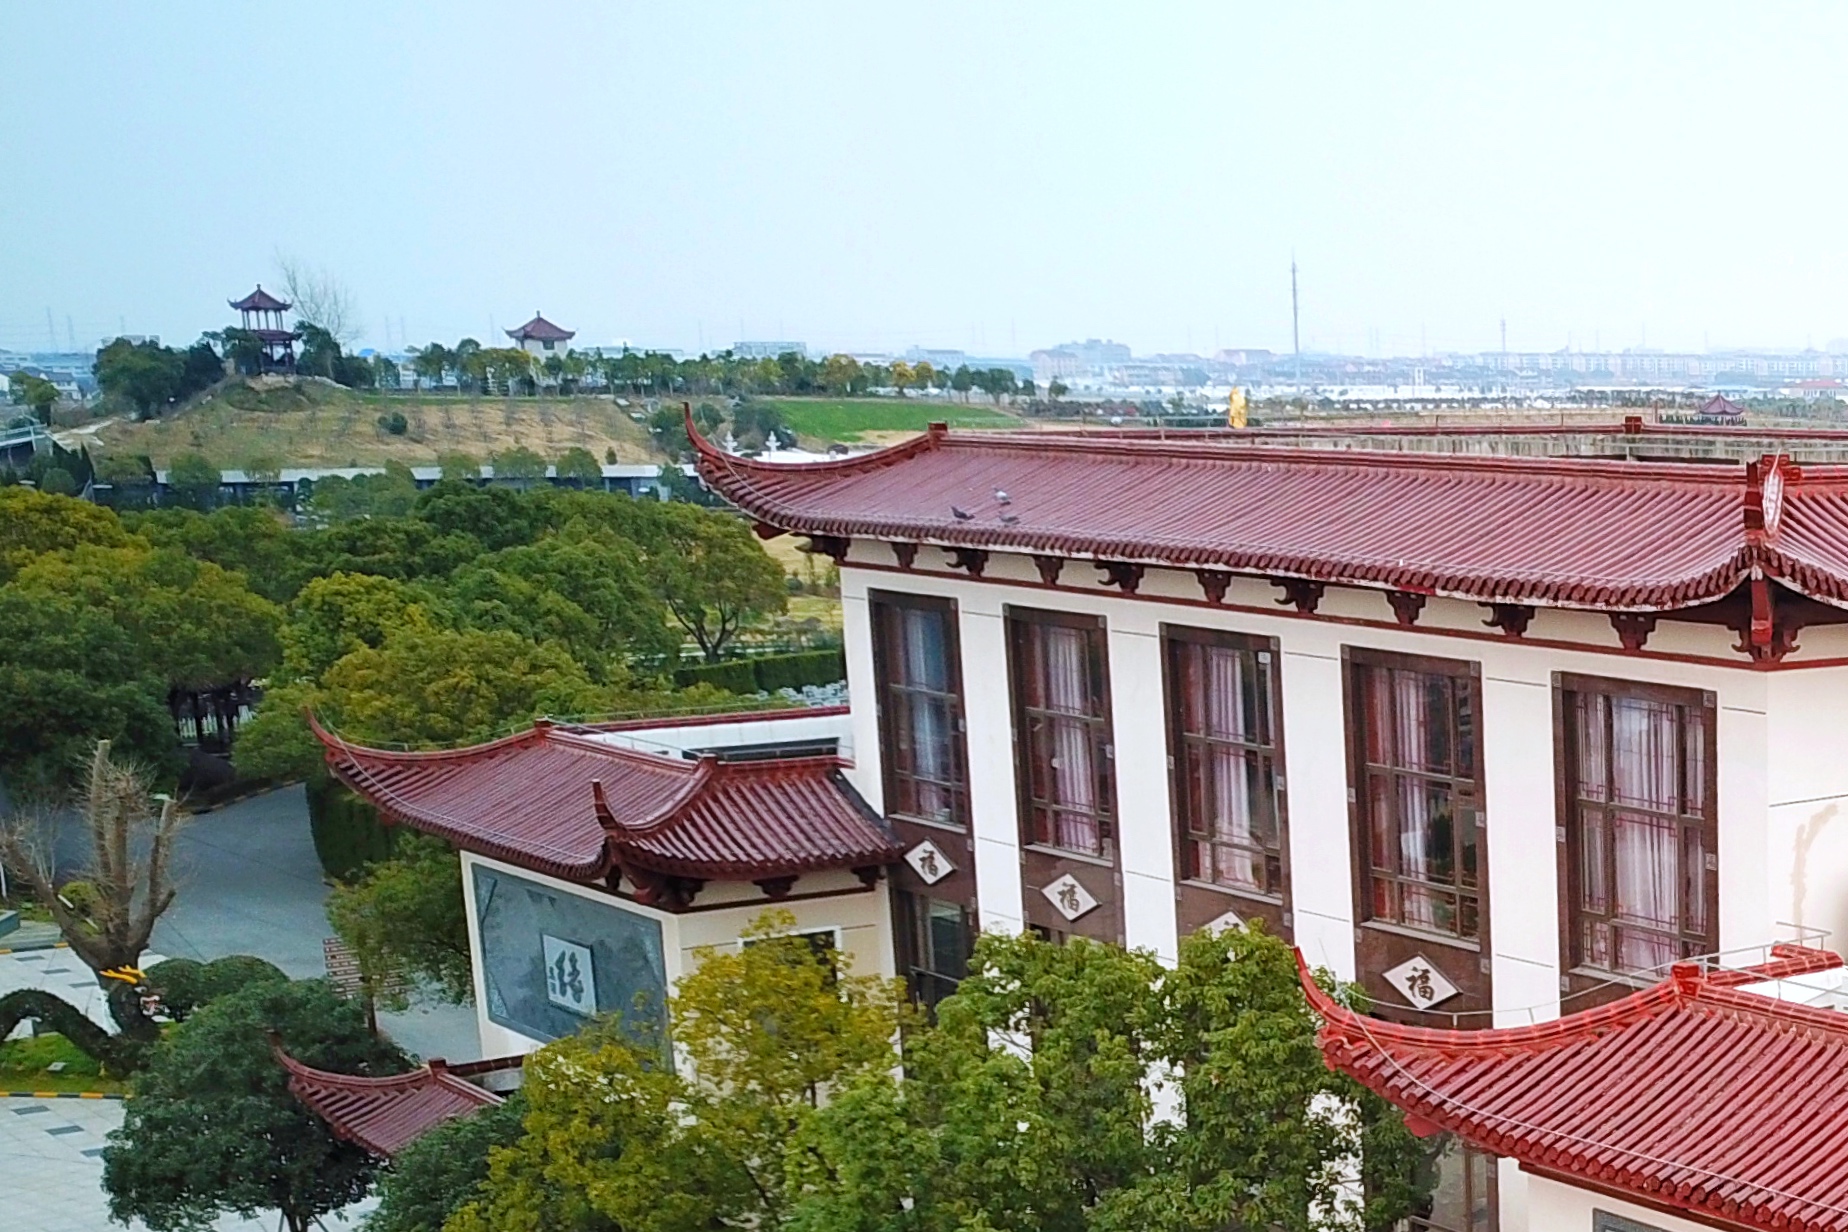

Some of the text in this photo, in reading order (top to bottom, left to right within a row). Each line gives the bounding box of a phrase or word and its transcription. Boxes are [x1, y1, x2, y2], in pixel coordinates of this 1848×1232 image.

[919, 849, 941, 876] 福
[1057, 883, 1082, 912] 福
[1405, 966, 1436, 1001] 福
